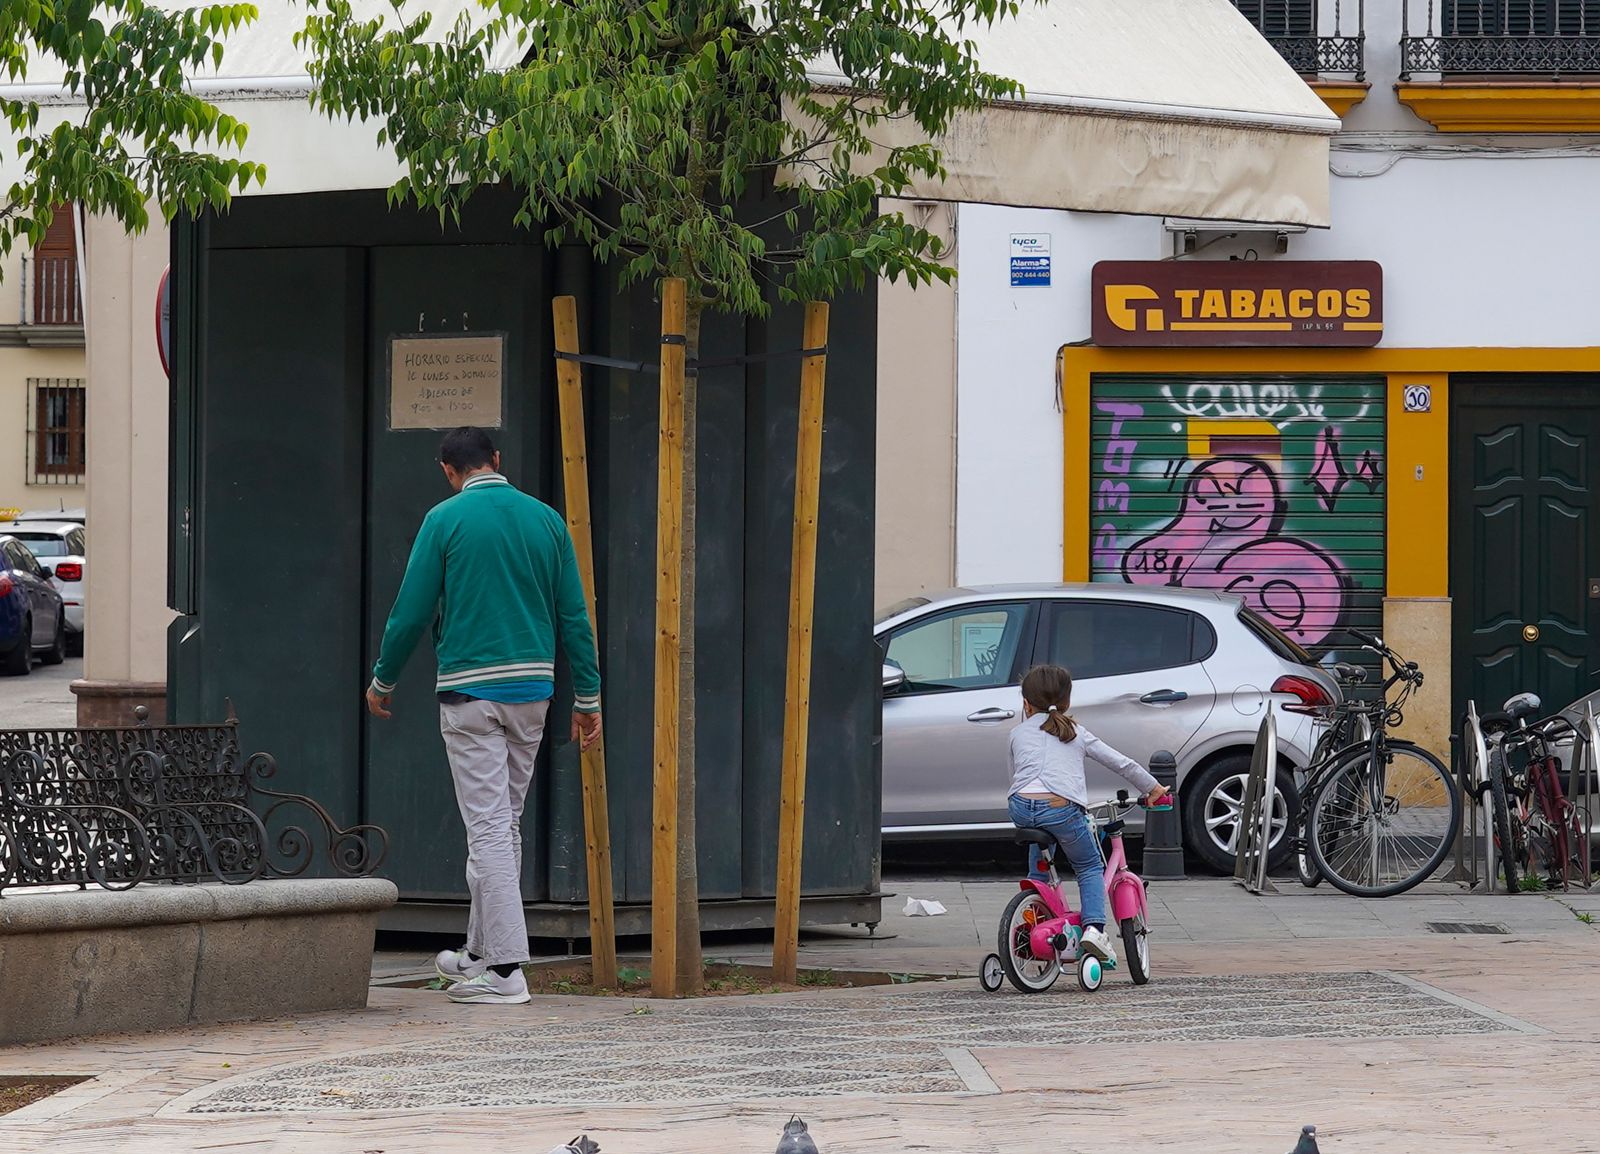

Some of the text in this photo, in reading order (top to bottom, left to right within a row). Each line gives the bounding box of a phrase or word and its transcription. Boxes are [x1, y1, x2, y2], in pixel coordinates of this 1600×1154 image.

[1012, 237, 1037, 246] tyco
[1011, 259, 1040, 267] Alarma
[1174, 289, 1371, 318] TABACOS
[404, 352, 496, 367] HORARIO ESPECIAL
[422, 371, 450, 381] LUNES
[462, 369, 499, 379] DOMINGO
